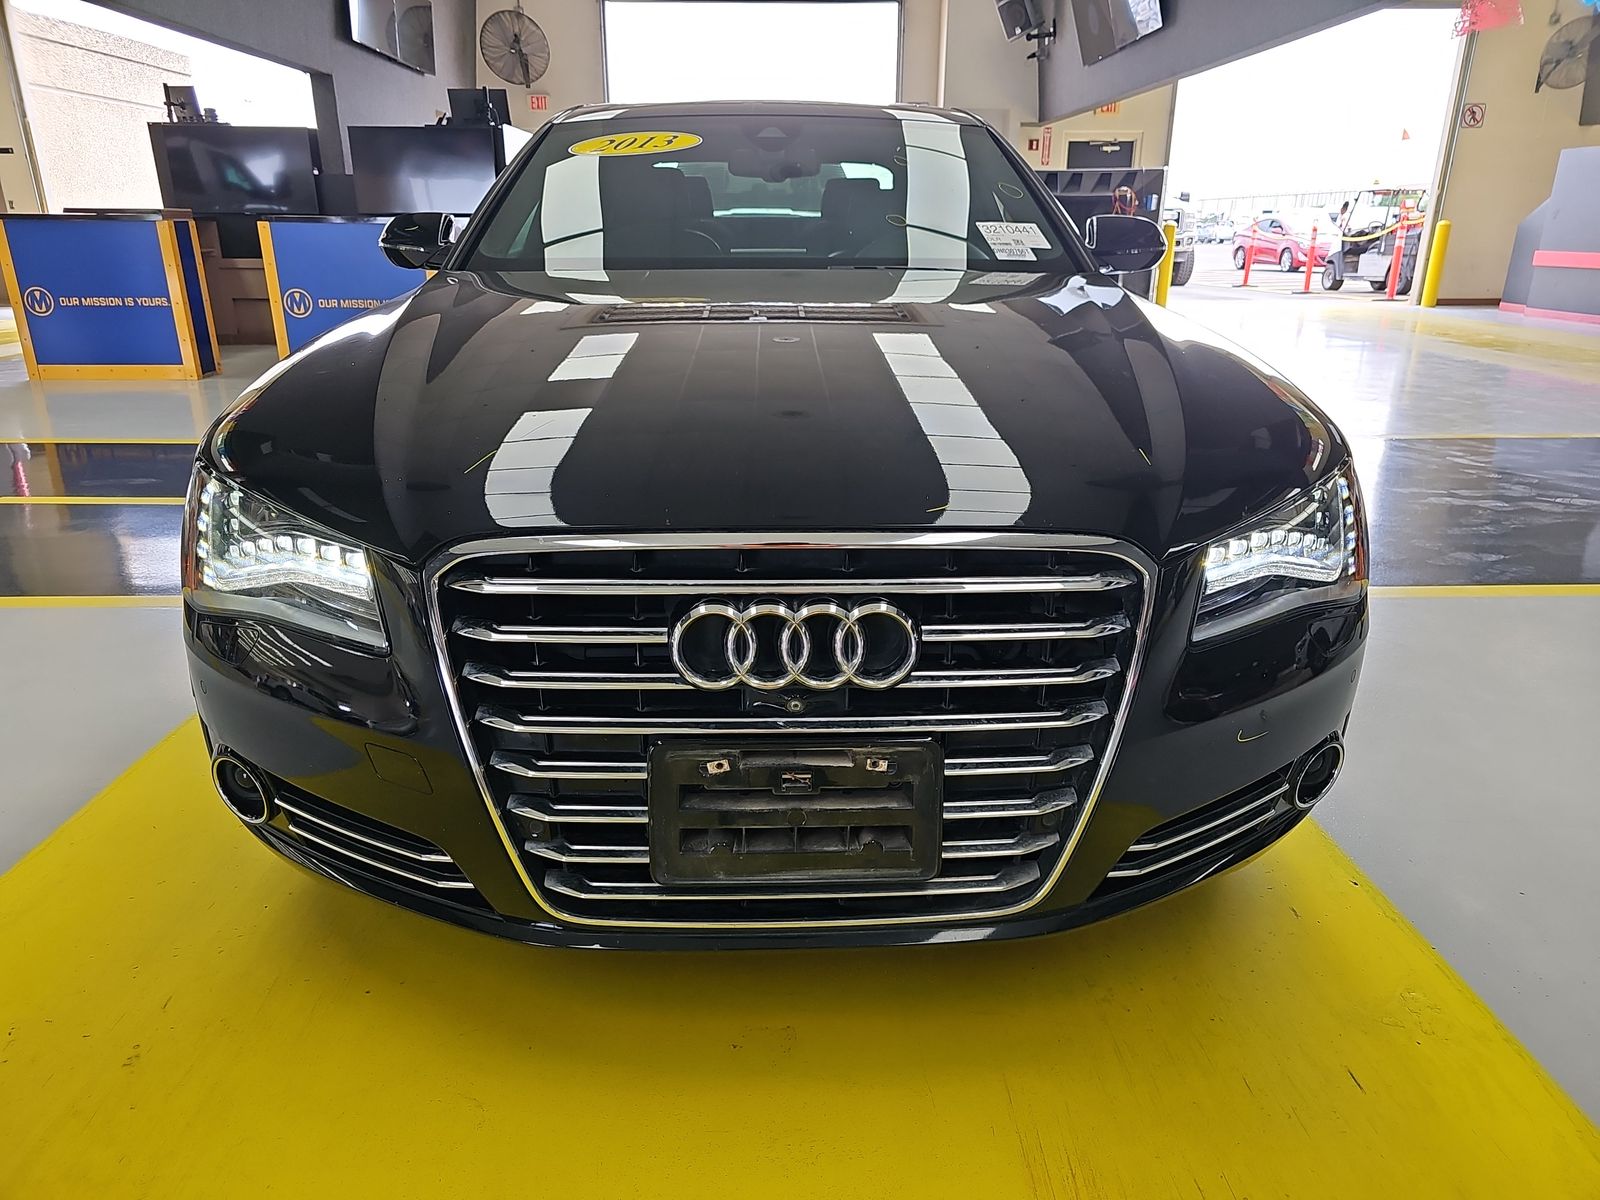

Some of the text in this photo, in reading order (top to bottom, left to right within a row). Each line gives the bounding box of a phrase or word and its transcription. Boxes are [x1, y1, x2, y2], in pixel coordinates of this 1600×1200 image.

[530, 95, 547, 111] EXIT
[589, 135, 679, 153] 2013
[982, 224, 1037, 235] 3210441
[59, 296, 171, 307] OUR MISSION IS YOURS.
[318, 299, 338, 308] OUR
[340, 299, 381, 309] MISSION
